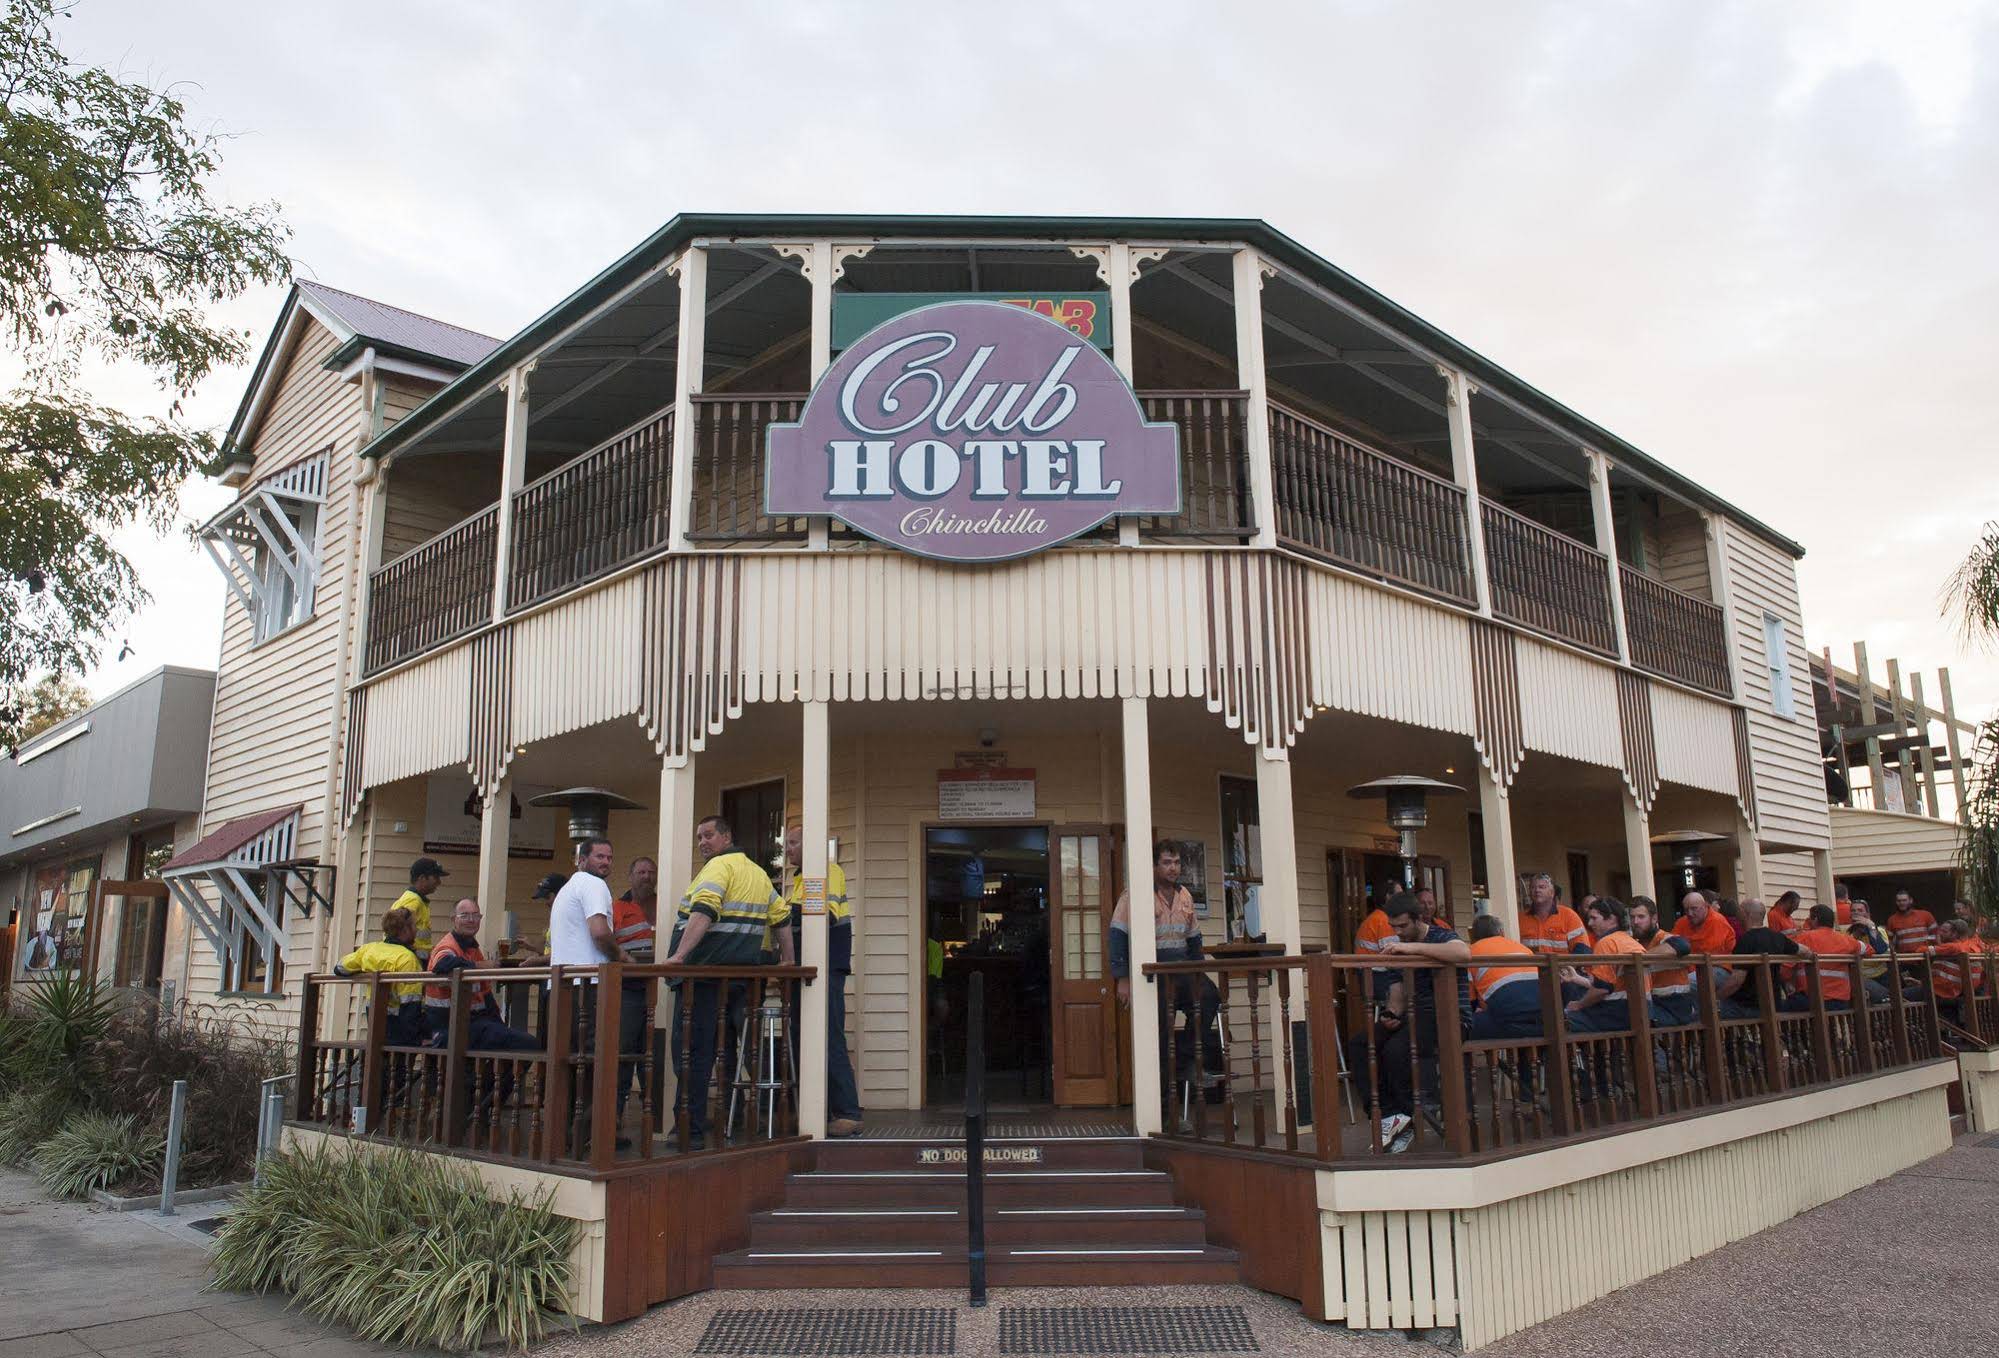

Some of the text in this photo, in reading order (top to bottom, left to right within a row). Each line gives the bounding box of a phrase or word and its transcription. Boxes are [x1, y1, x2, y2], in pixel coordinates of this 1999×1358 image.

[840, 331, 1087, 437] Club
[826, 439, 1123, 498] HOTEL
[900, 507, 1048, 538] Chinchilla
[921, 1147, 1038, 1161] NO DOG ALLOWED
